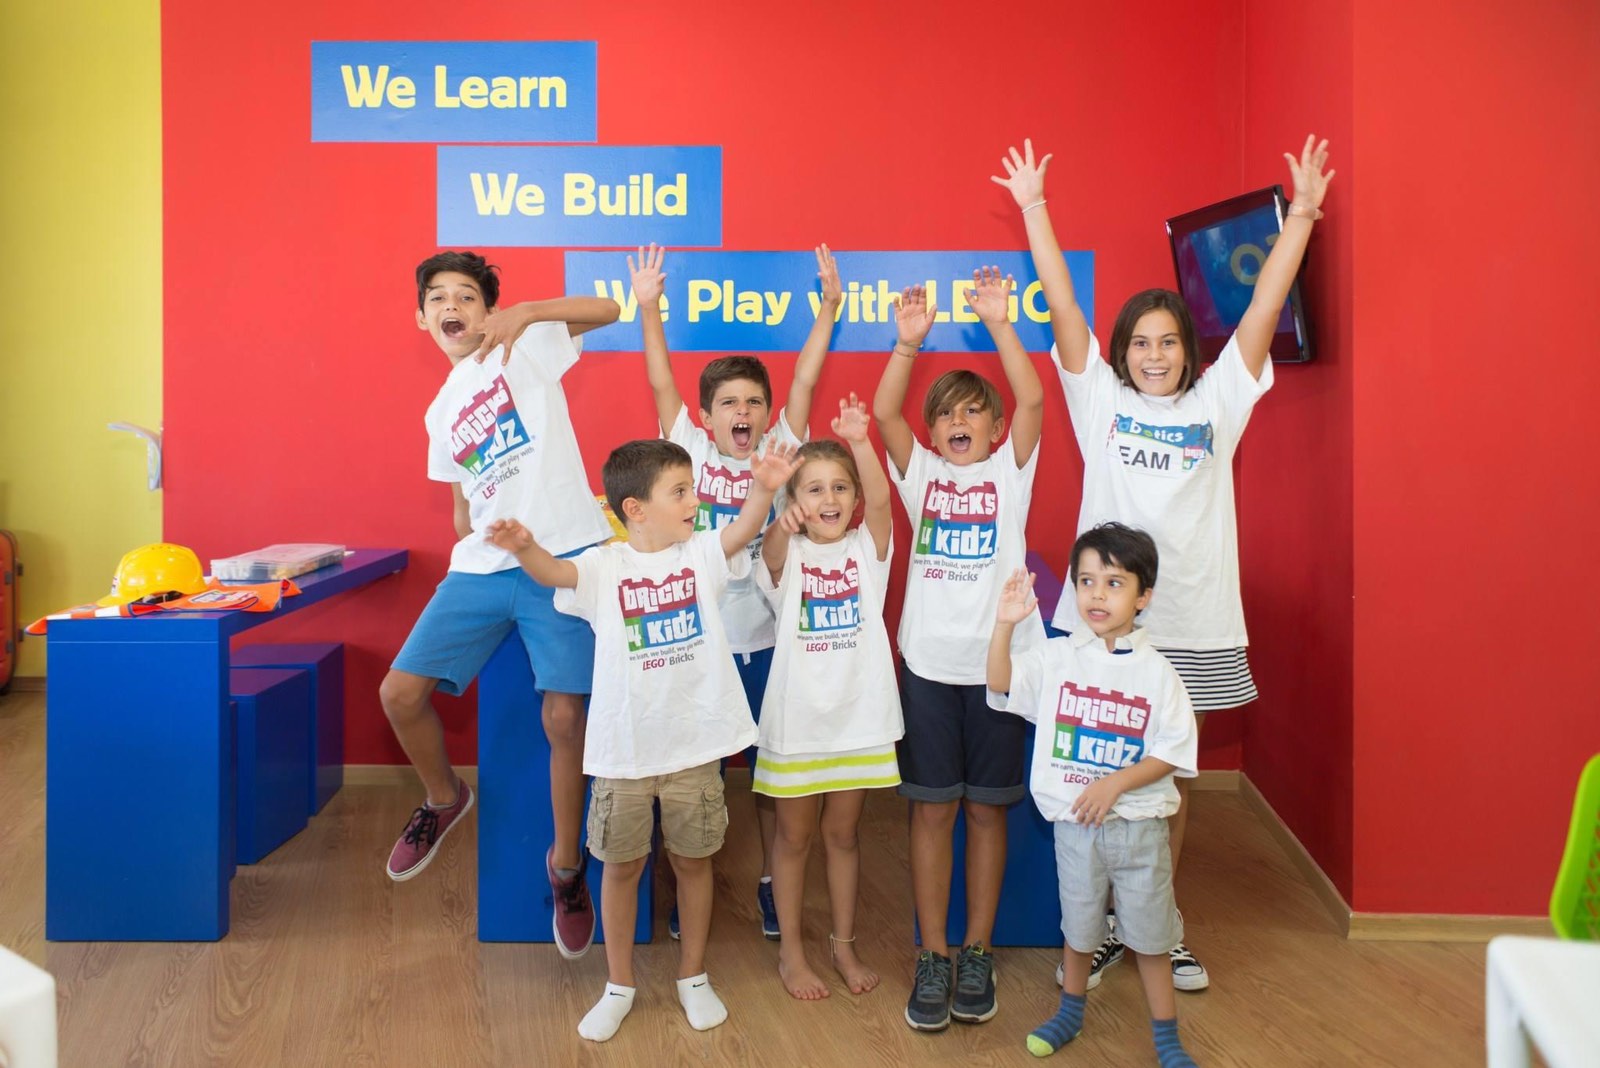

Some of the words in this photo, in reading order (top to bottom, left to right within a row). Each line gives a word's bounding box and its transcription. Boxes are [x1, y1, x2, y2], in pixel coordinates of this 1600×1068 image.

[340, 65, 416, 108] We
[434, 65, 567, 108] Learn
[470, 173, 545, 216] We
[563, 173, 687, 216] Build
[688, 280, 791, 326] Play
[920, 526, 932, 546] 4
[948, 570, 978, 582] Bricks
[625, 623, 642, 647] 4
[806, 642, 828, 652] LEGO
[832, 639, 857, 651] Bricks
[642, 658, 665, 671] LEGO
[669, 653, 694, 666] Bricks
[1056, 730, 1072, 757] 4
[1064, 773, 1090, 785] LEGO
